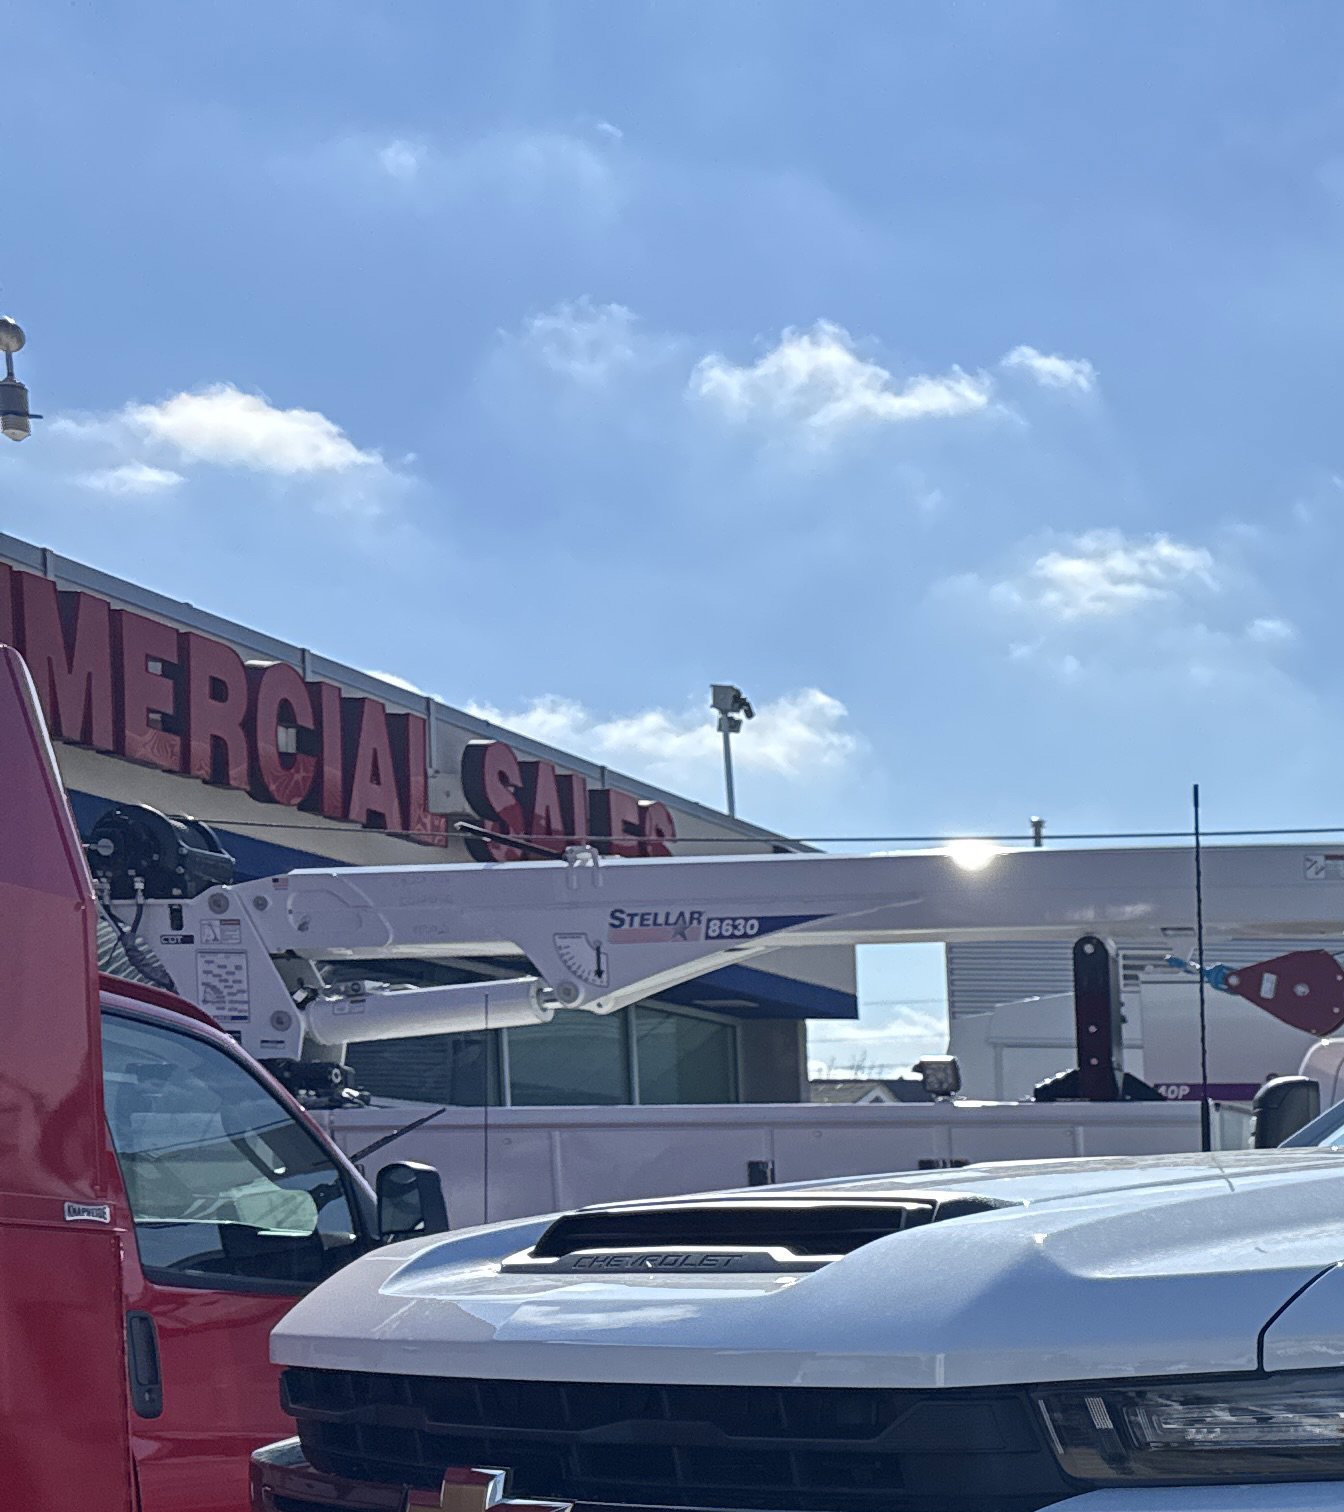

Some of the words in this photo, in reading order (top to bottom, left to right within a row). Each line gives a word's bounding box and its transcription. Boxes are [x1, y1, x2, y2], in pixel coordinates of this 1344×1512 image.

[609, 908, 705, 929] STELLAR
[707, 919, 760, 938] 8630
[572, 1253, 743, 1269] CHEVROLET
